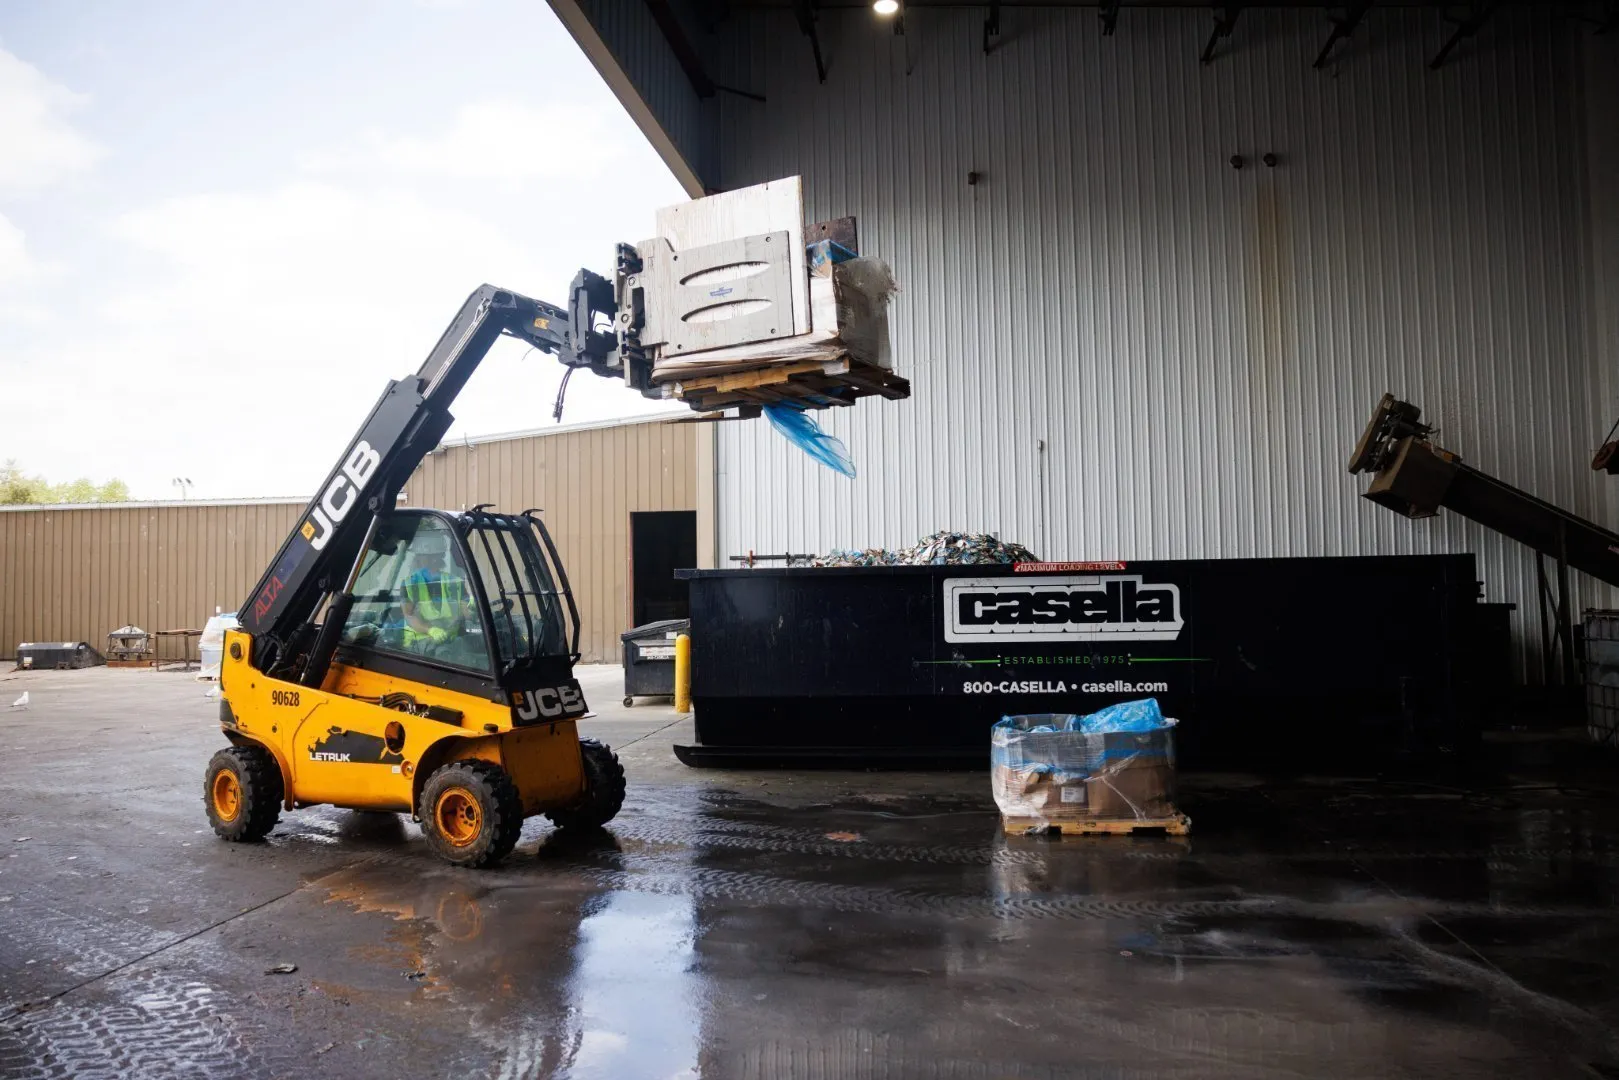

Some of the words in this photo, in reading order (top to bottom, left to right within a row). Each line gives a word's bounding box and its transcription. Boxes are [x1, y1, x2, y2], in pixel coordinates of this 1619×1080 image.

[311, 440, 380, 551] JCB
[1020, 563, 1057, 572] MAXIMUM
[1059, 563, 1094, 571] LOADING
[255, 575, 284, 625] ALTA
[958, 580, 1176, 626] casella
[1003, 656, 1091, 665] ESTABLISHED
[1097, 655, 1124, 664] 1975
[963, 681, 1067, 693] 800-CASELLA
[1081, 680, 1168, 693] casella.com
[272, 690, 300, 707] 90628
[517, 685, 585, 720] JCB
[309, 752, 350, 762] LETRUK
